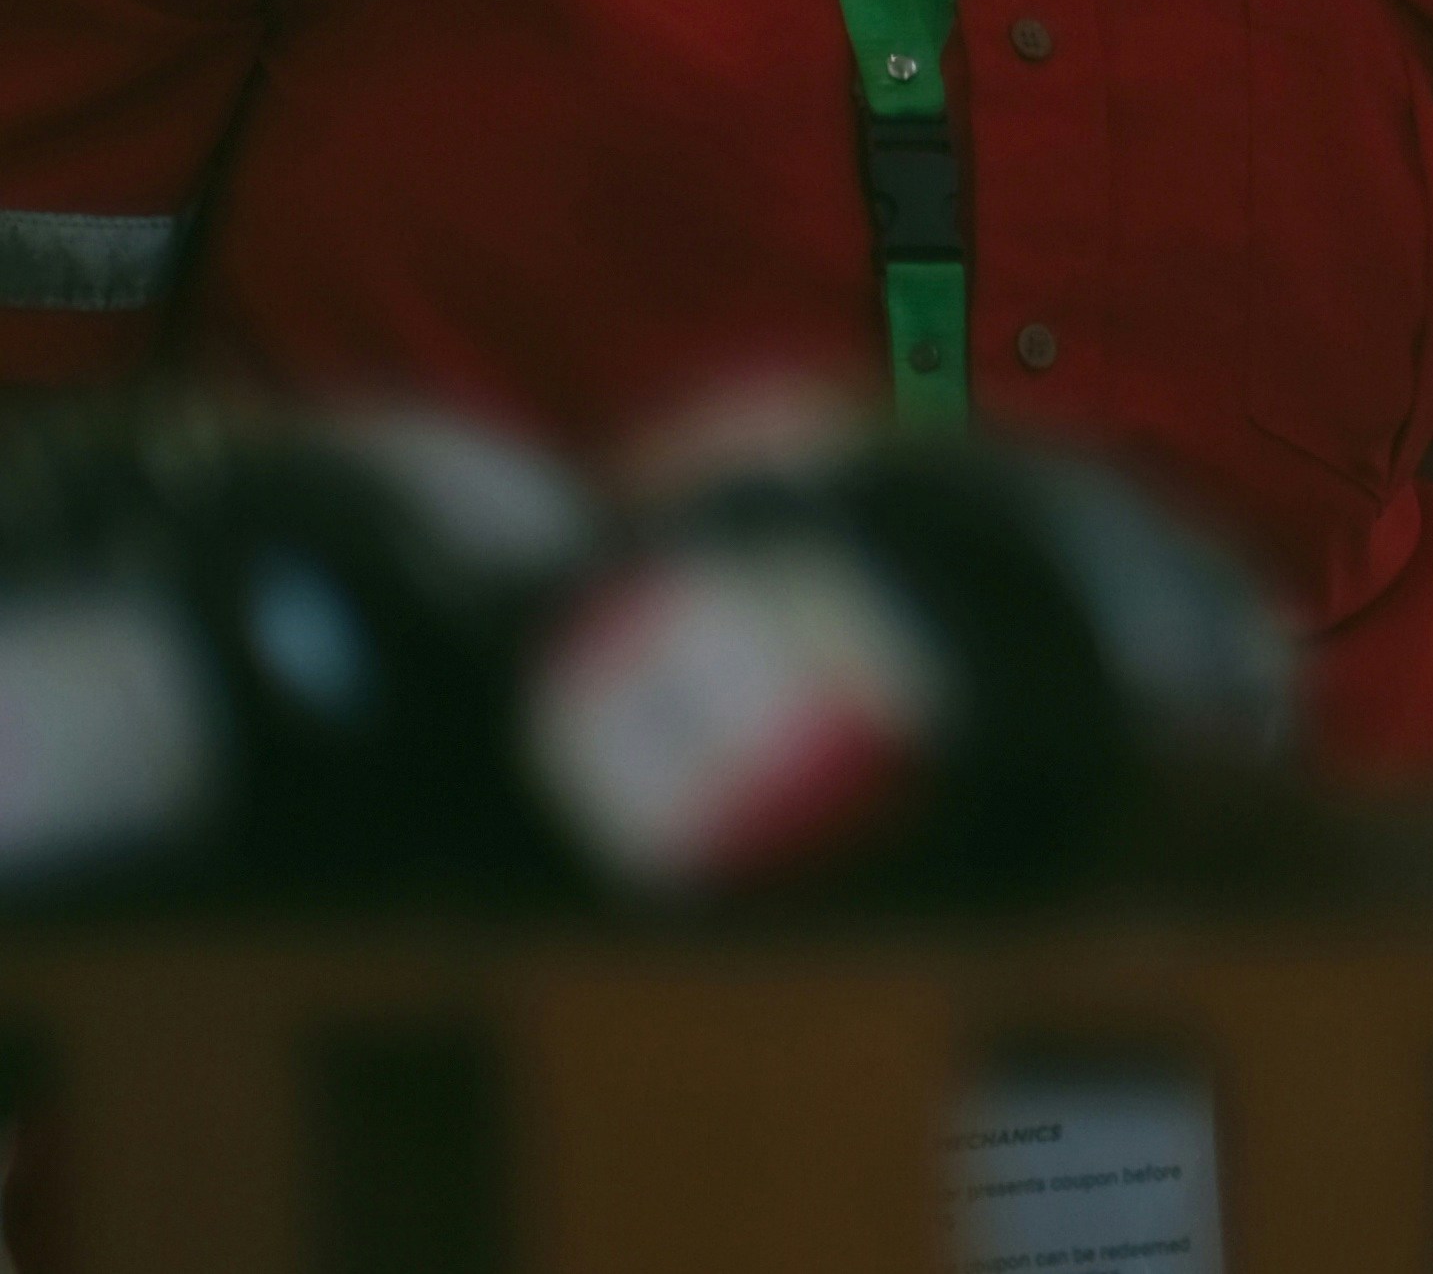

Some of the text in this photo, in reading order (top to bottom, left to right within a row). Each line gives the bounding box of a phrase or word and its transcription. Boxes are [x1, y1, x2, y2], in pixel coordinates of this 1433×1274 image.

[1050, 1171, 1118, 1193] coupon
[1122, 1164, 1182, 1185] before
[1035, 1250, 1069, 1267] can
[1072, 1246, 1096, 1264] be
[1099, 1236, 1191, 1260] redeemed
